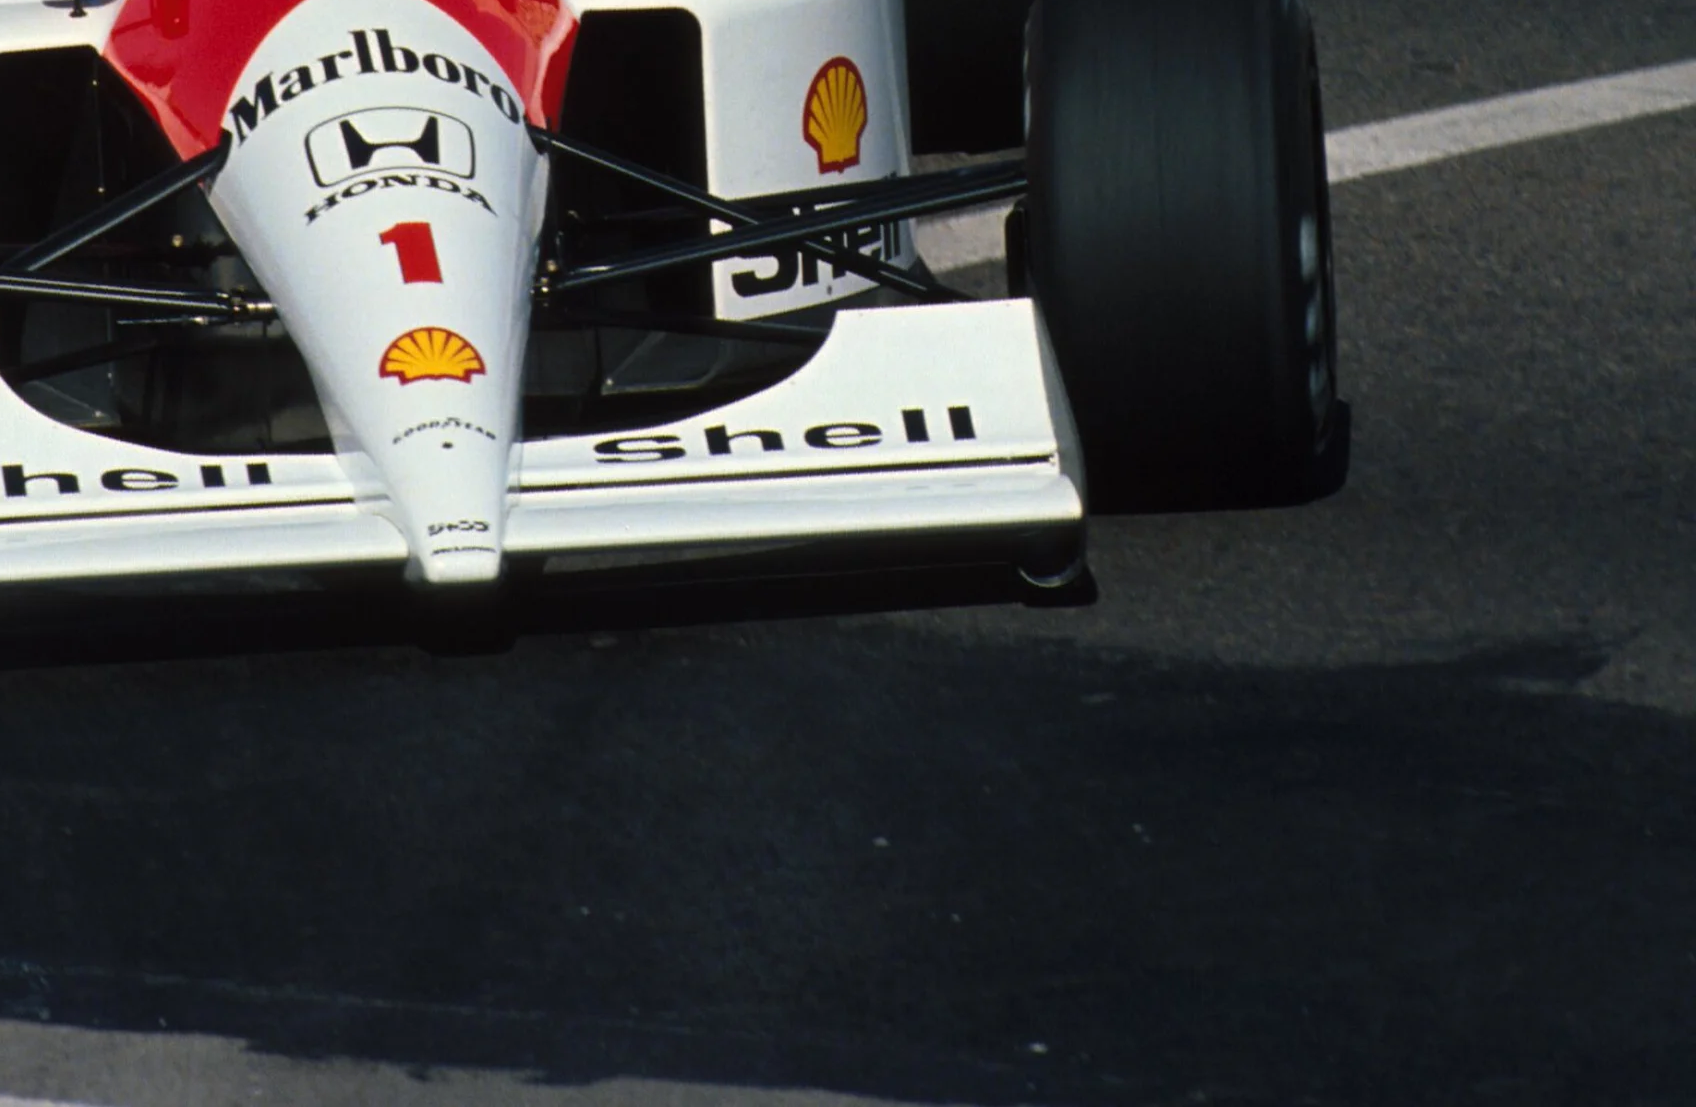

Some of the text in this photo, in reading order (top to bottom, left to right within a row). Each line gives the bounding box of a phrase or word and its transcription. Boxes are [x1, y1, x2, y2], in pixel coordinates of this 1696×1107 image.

[228, 27, 521, 148] Marlboro
[303, 173, 499, 227] HONDA
[378, 221, 444, 285] 1
[594, 405, 976, 465] Shell
